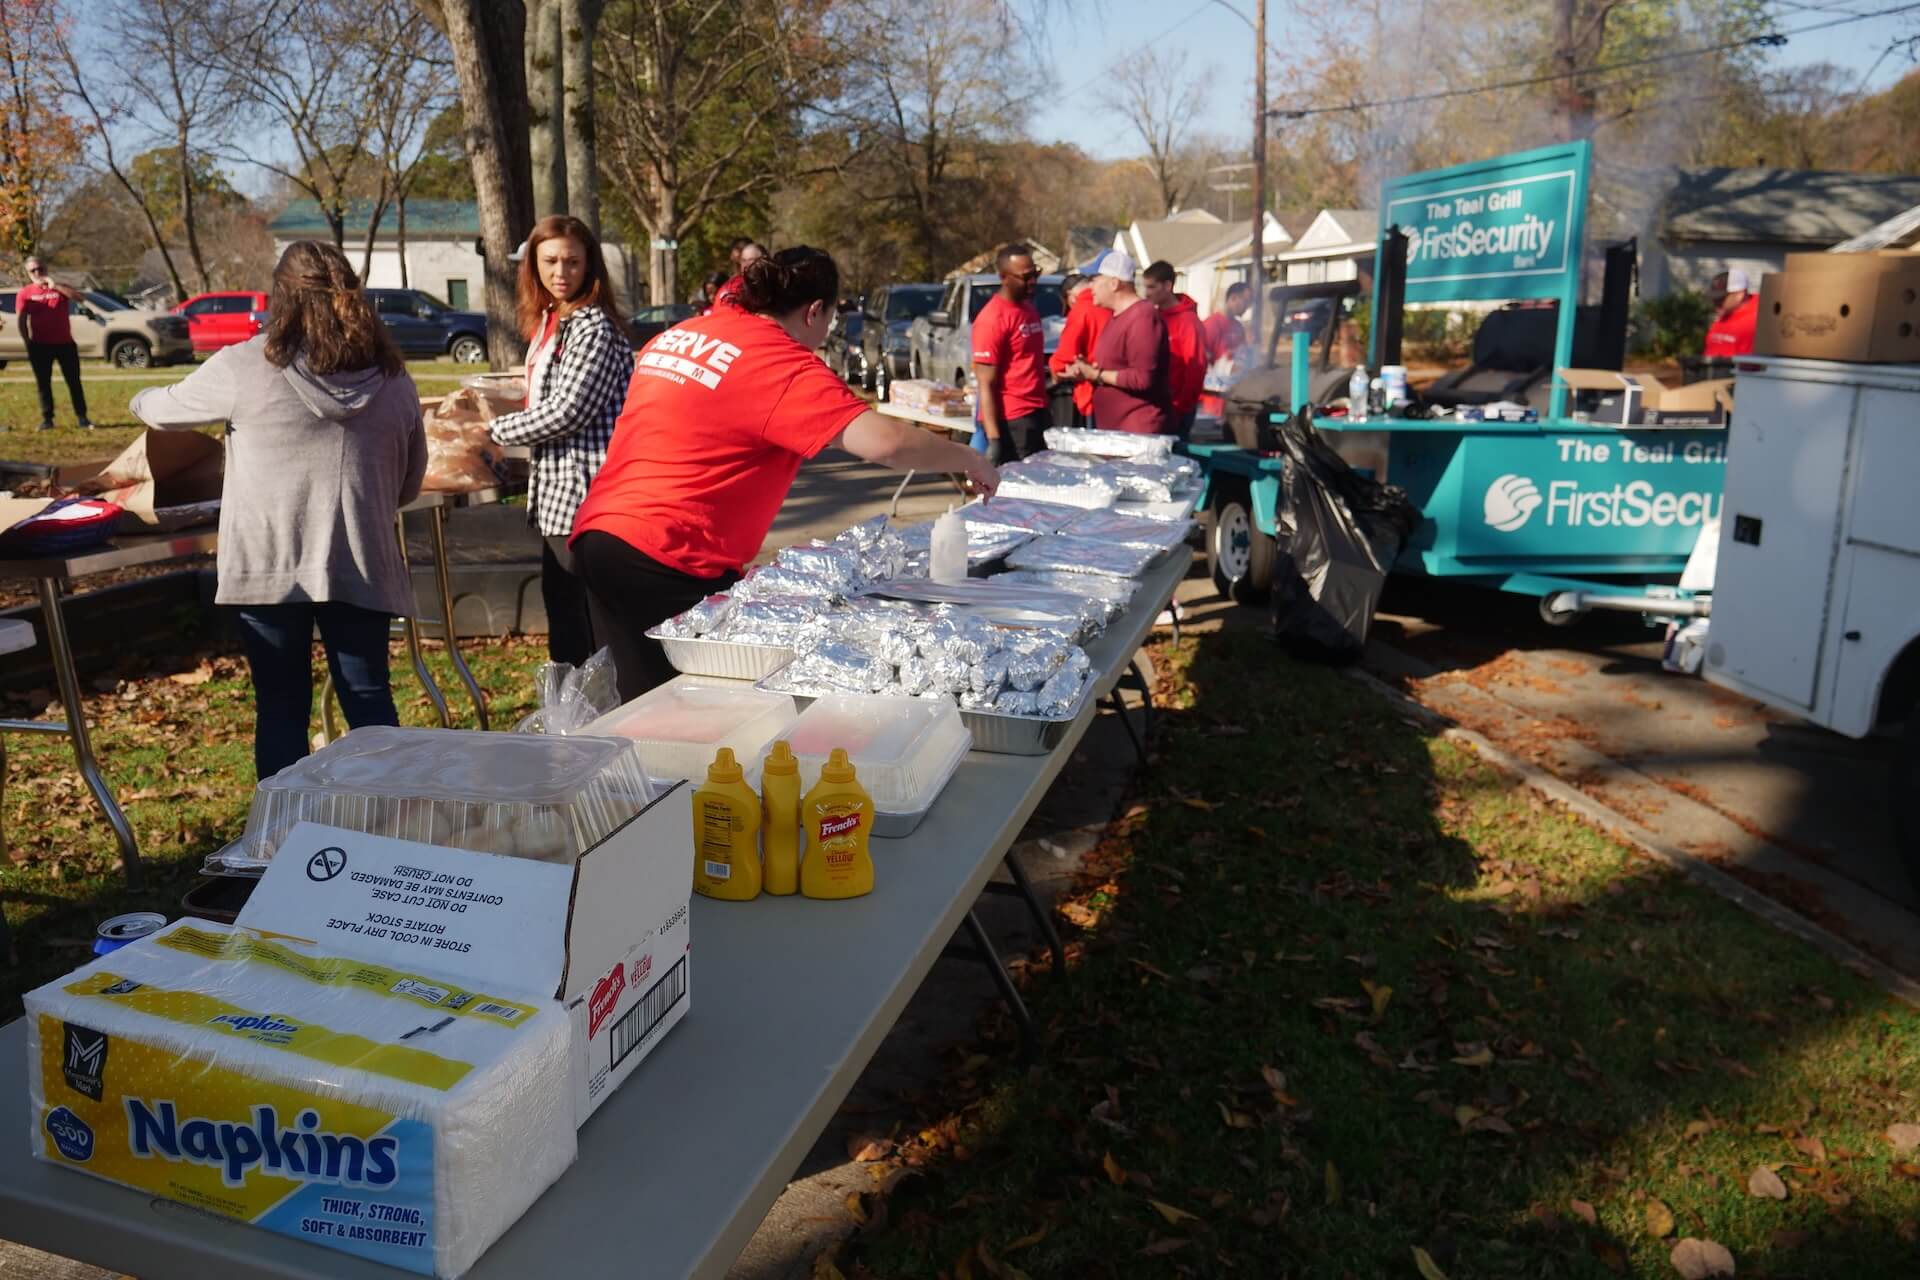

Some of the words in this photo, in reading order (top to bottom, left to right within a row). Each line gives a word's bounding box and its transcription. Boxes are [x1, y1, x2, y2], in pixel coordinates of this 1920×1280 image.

[1427, 203, 1451, 220] The
[1455, 195, 1484, 216] Teal
[1488, 189, 1522, 211] Grill
[1422, 214, 1554, 260] FirstSecurity
[1557, 438, 1610, 463] The
[1618, 440, 1673, 463] Teal
[822, 817, 857, 836] French's
[350, 871, 402, 889] DAMAGED.
[404, 881, 420, 892] BE
[432, 873, 455, 885] NOT
[456, 877, 473, 887] DO
[421, 885, 442, 896] MAY
[445, 888, 504, 906] CONTENTS
[402, 895, 424, 907] CUT
[425, 897, 448, 911] NOT
[451, 902, 468, 913] DO
[326, 918, 364, 933] PLACE
[366, 912, 403, 928] STOCK
[404, 920, 446, 934] ROTATE
[364, 926, 388, 939] DRY
[391, 930, 419, 944] COOL
[421, 935, 433, 947] IN
[433, 938, 472, 953] STORE
[591, 975, 622, 1022] French's
[127, 1098, 397, 1185] Napkins
[321, 1198, 364, 1220] THICK,
[368, 1204, 425, 1227] STRONG,
[302, 1219, 335, 1236] SOFT
[336, 1224, 346, 1237] &
[349, 1226, 427, 1247] ABSORBENT
